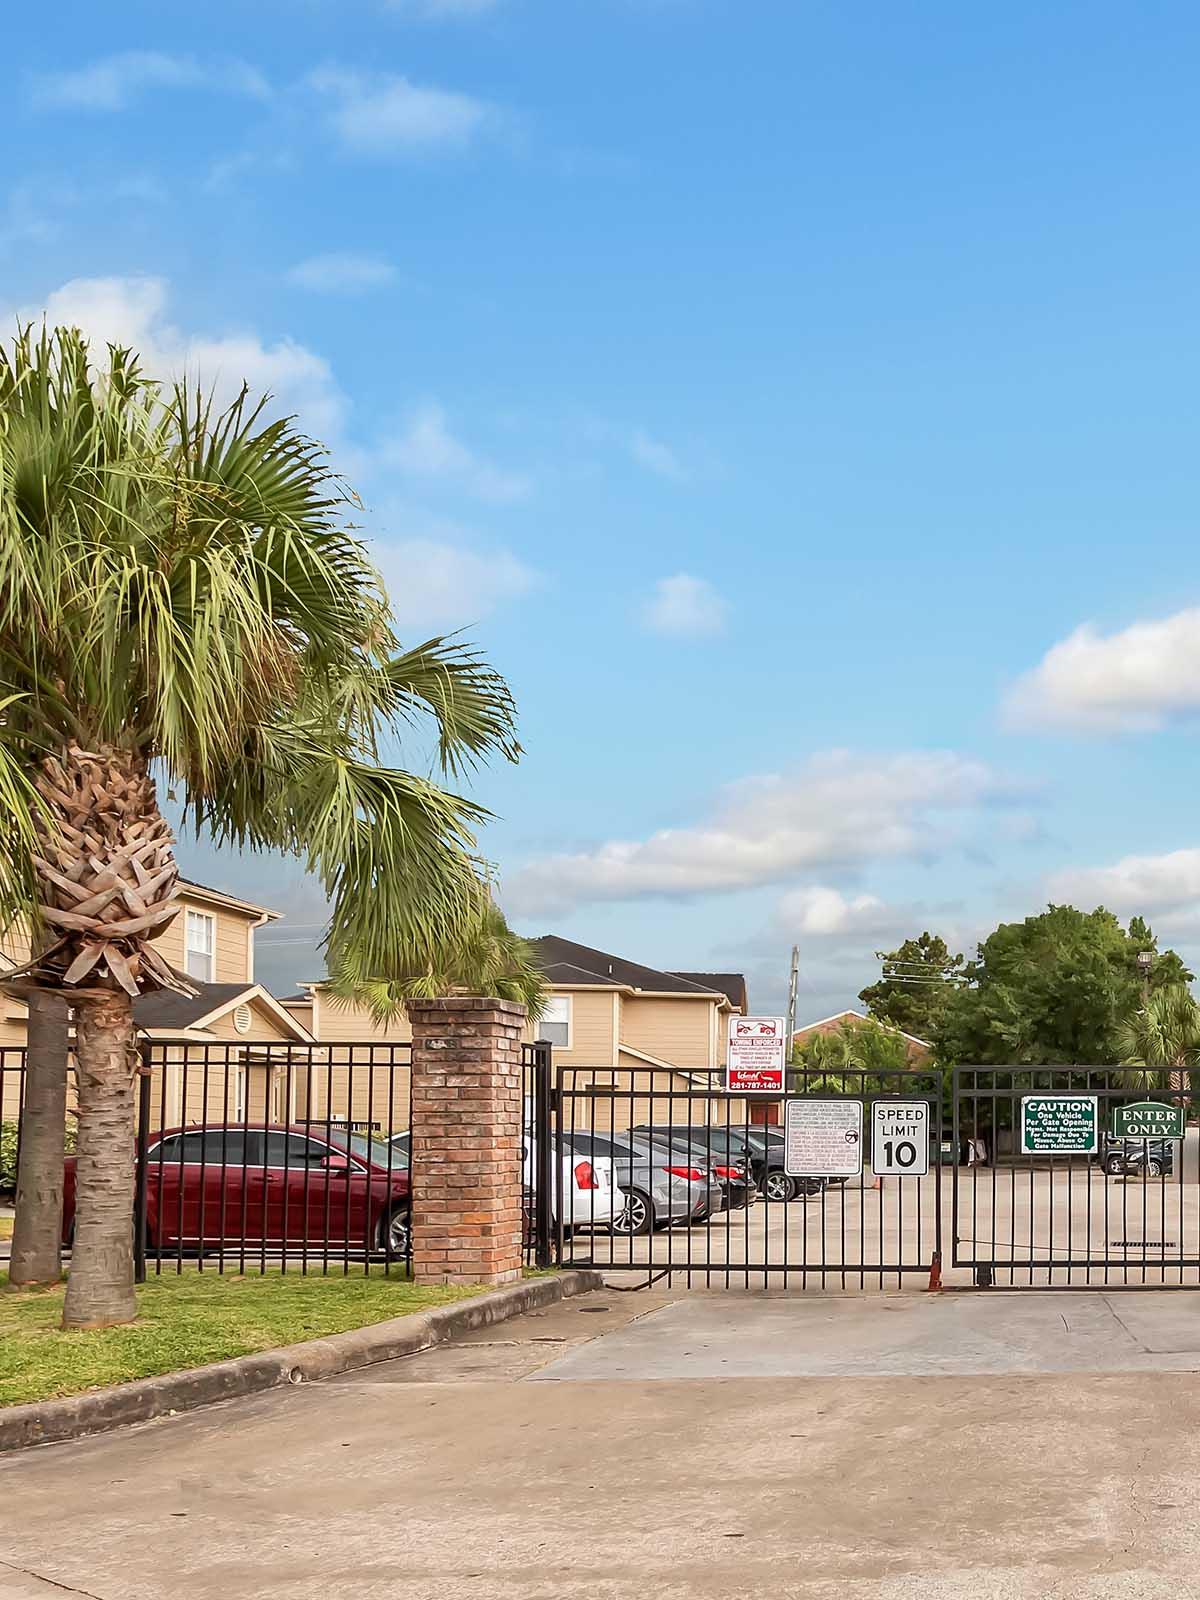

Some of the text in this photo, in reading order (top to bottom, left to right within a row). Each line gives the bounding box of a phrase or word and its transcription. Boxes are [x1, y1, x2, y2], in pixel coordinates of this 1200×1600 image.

[1028, 1102, 1092, 1111] CAUTION
[877, 1109, 924, 1120] SPEED
[1122, 1111, 1177, 1121] ENTER
[1062, 1119, 1093, 1127] Opening
[882, 1125, 918, 1136] LIMIT
[1127, 1124, 1171, 1135] ONLY
[883, 1141, 917, 1167] 10
